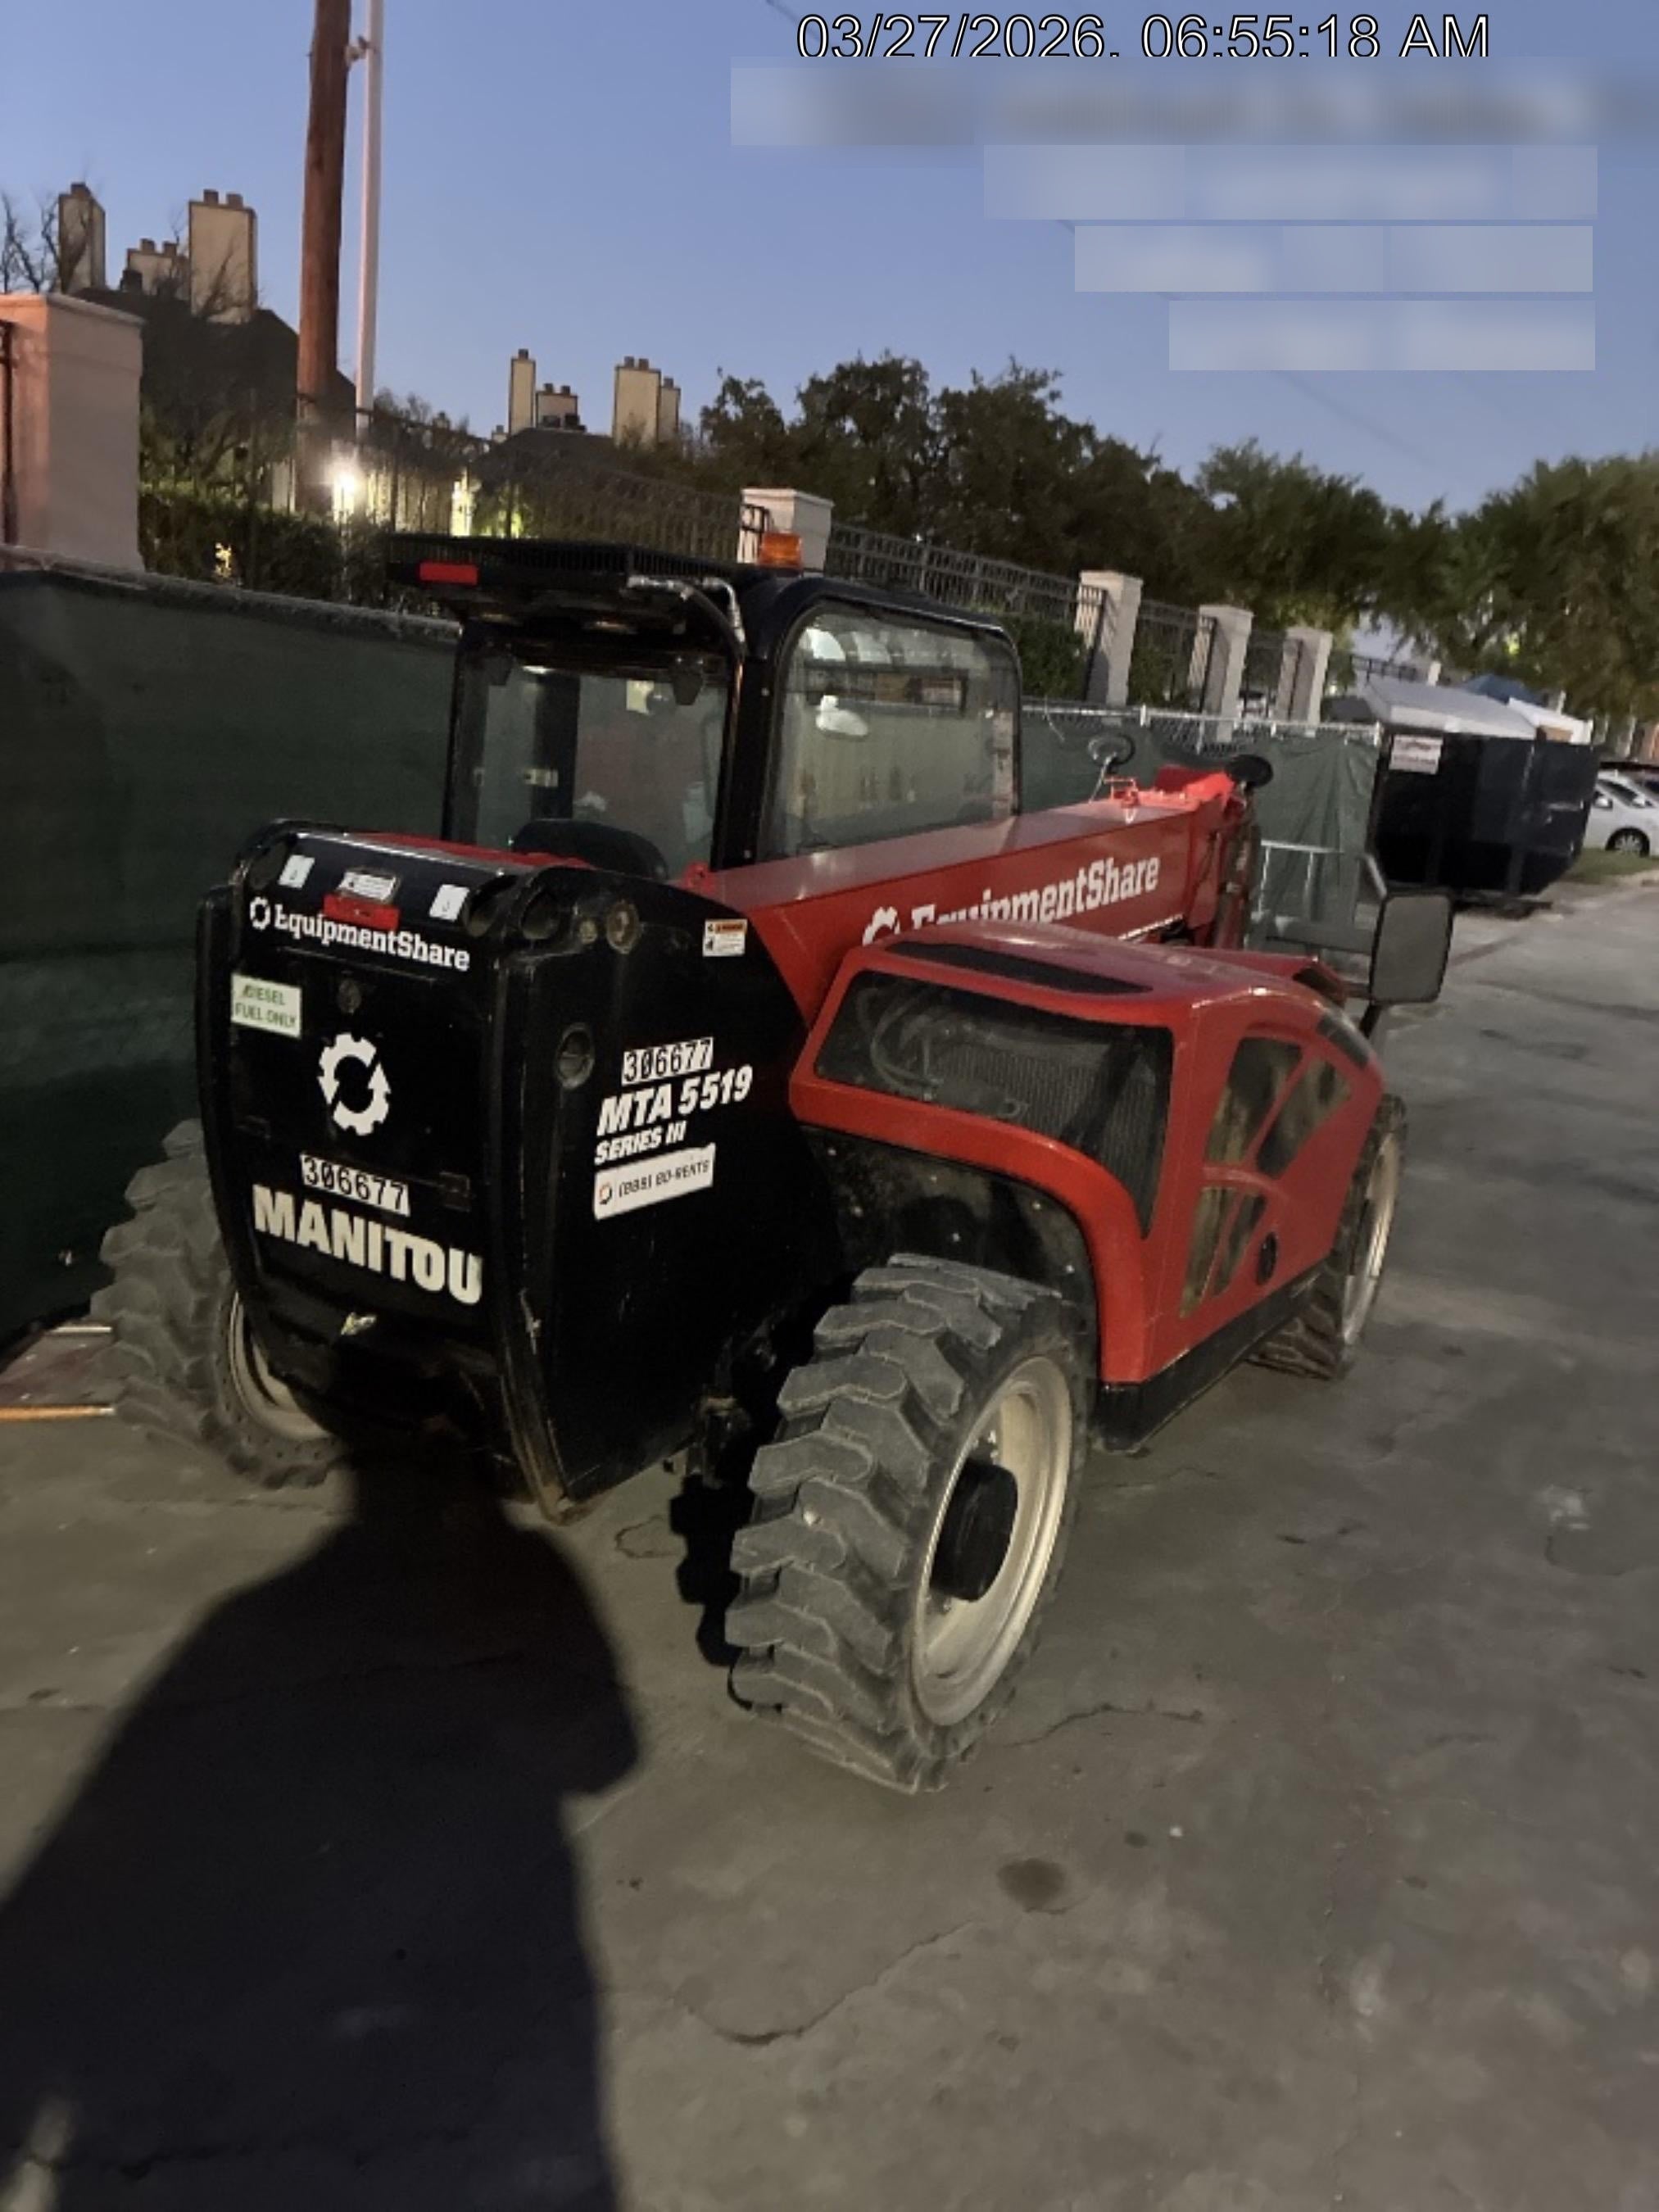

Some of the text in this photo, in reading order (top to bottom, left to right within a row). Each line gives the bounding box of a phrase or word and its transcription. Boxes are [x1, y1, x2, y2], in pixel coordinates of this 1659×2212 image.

[274, 903, 471, 971] EquipmentShare
[624, 1039, 711, 1082] 306677
[596, 1064, 753, 1136] MTA 5519
[594, 1127, 664, 1165] SERIES
[303, 1156, 404, 1210] 306677
[252, 1184, 483, 1304] MANITOU
